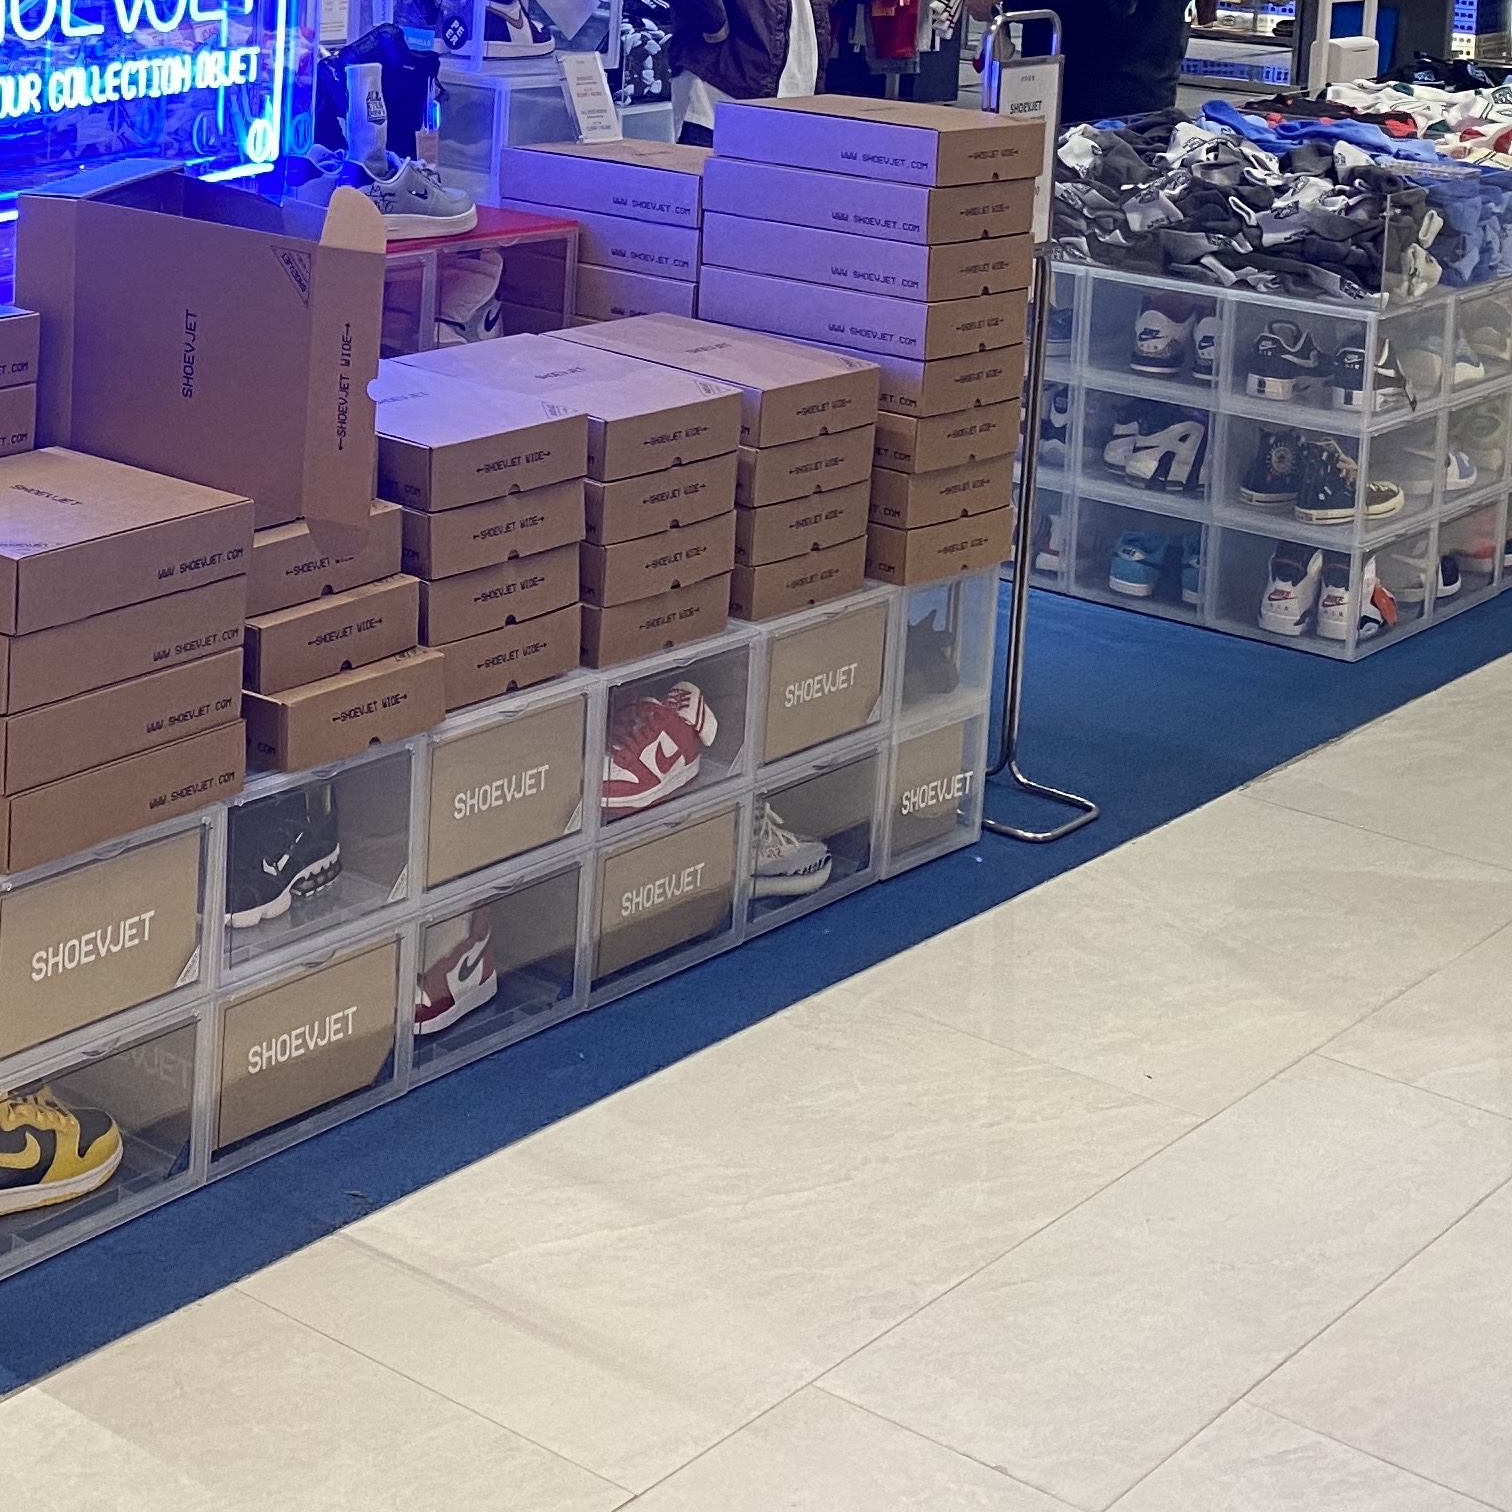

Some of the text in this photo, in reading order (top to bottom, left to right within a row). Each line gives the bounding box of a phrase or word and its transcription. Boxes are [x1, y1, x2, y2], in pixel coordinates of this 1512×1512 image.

[48, 49, 190, 113] COLLECTION
[194, 46, 262, 90] OBJET
[181, 309, 200, 399] SHOEVJET
[336, 334, 352, 439] SHOEVJET WIDE
[685, 426, 702, 438] WIDE
[484, 451, 544, 474] SHOEVJET WIDE
[683, 483, 700, 496] WIDE
[479, 516, 538, 540] SHOEVJET WIDE
[293, 557, 330, 575] SHOEVJET
[685, 547, 702, 559] WIDE
[479, 576, 539, 602] SHOEVJET WIDE
[678, 607, 695, 620] WIDE
[314, 619, 375, 646] SHOEVJET WIDE
[483, 643, 542, 669] SHOEVJET WIDE
[784, 662, 858, 708] SHOEVJET
[340, 694, 401, 721] SHOEVJET WIDE
[453, 765, 549, 821] SHOEVJET
[901, 771, 974, 816] SHOEVJET
[621, 862, 706, 917] SHOEVJET
[31, 909, 157, 982] SHOEVJET
[247, 1006, 358, 1074] SHOEVJET
